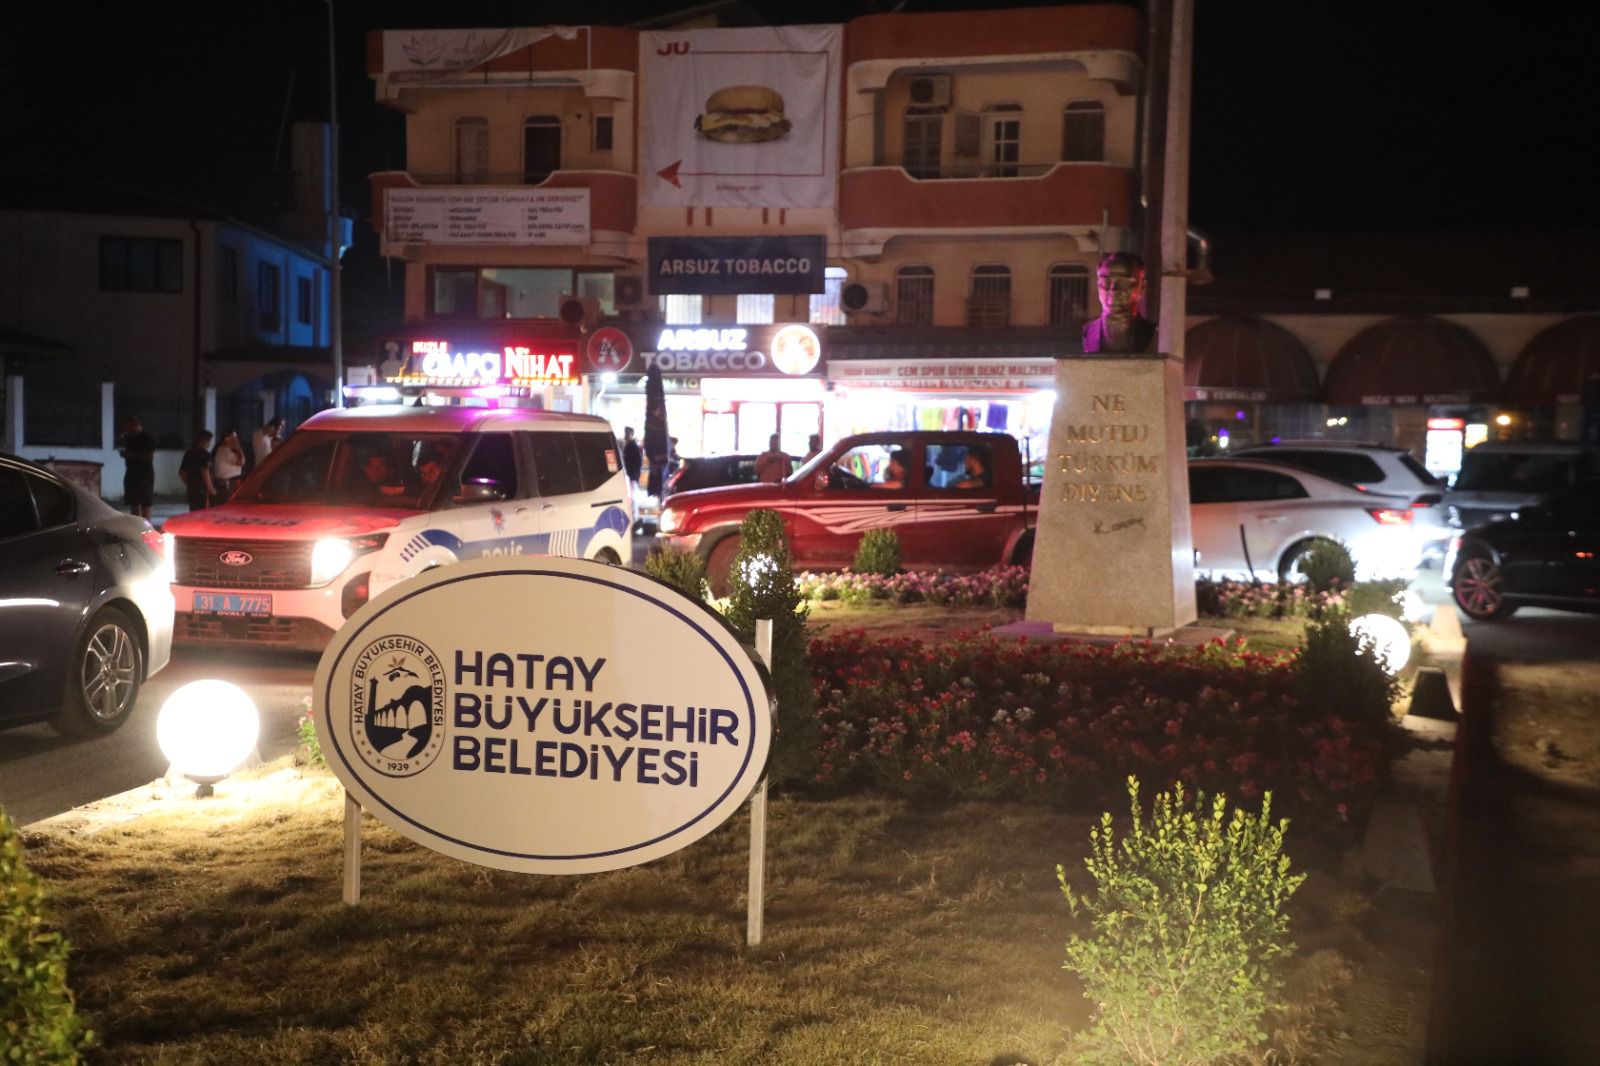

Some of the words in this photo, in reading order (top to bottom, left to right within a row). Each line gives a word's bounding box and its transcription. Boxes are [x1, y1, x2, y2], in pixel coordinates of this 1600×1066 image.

[660, 259, 720, 275] ARSUZ
[725, 258, 811, 274] TOBACCO
[657, 328, 748, 351] ARSUZ
[640, 351, 766, 370] TOBACCO
[897, 366, 918, 377] CEM
[921, 366, 945, 377] SPOR
[1091, 394, 1126, 413] NE
[1066, 424, 1149, 444] MUTLU
[200, 595, 214, 610] 31
[223, 596, 232, 610] A
[239, 596, 271, 612] 7775
[455, 650, 606, 692] HATAY
[354, 684, 365, 724] HATAY
[454, 693, 740, 747] BÜYÜKŞEHİR
[387, 761, 410, 772] 1939
[452, 735, 699, 788] BELEDİYESİ
